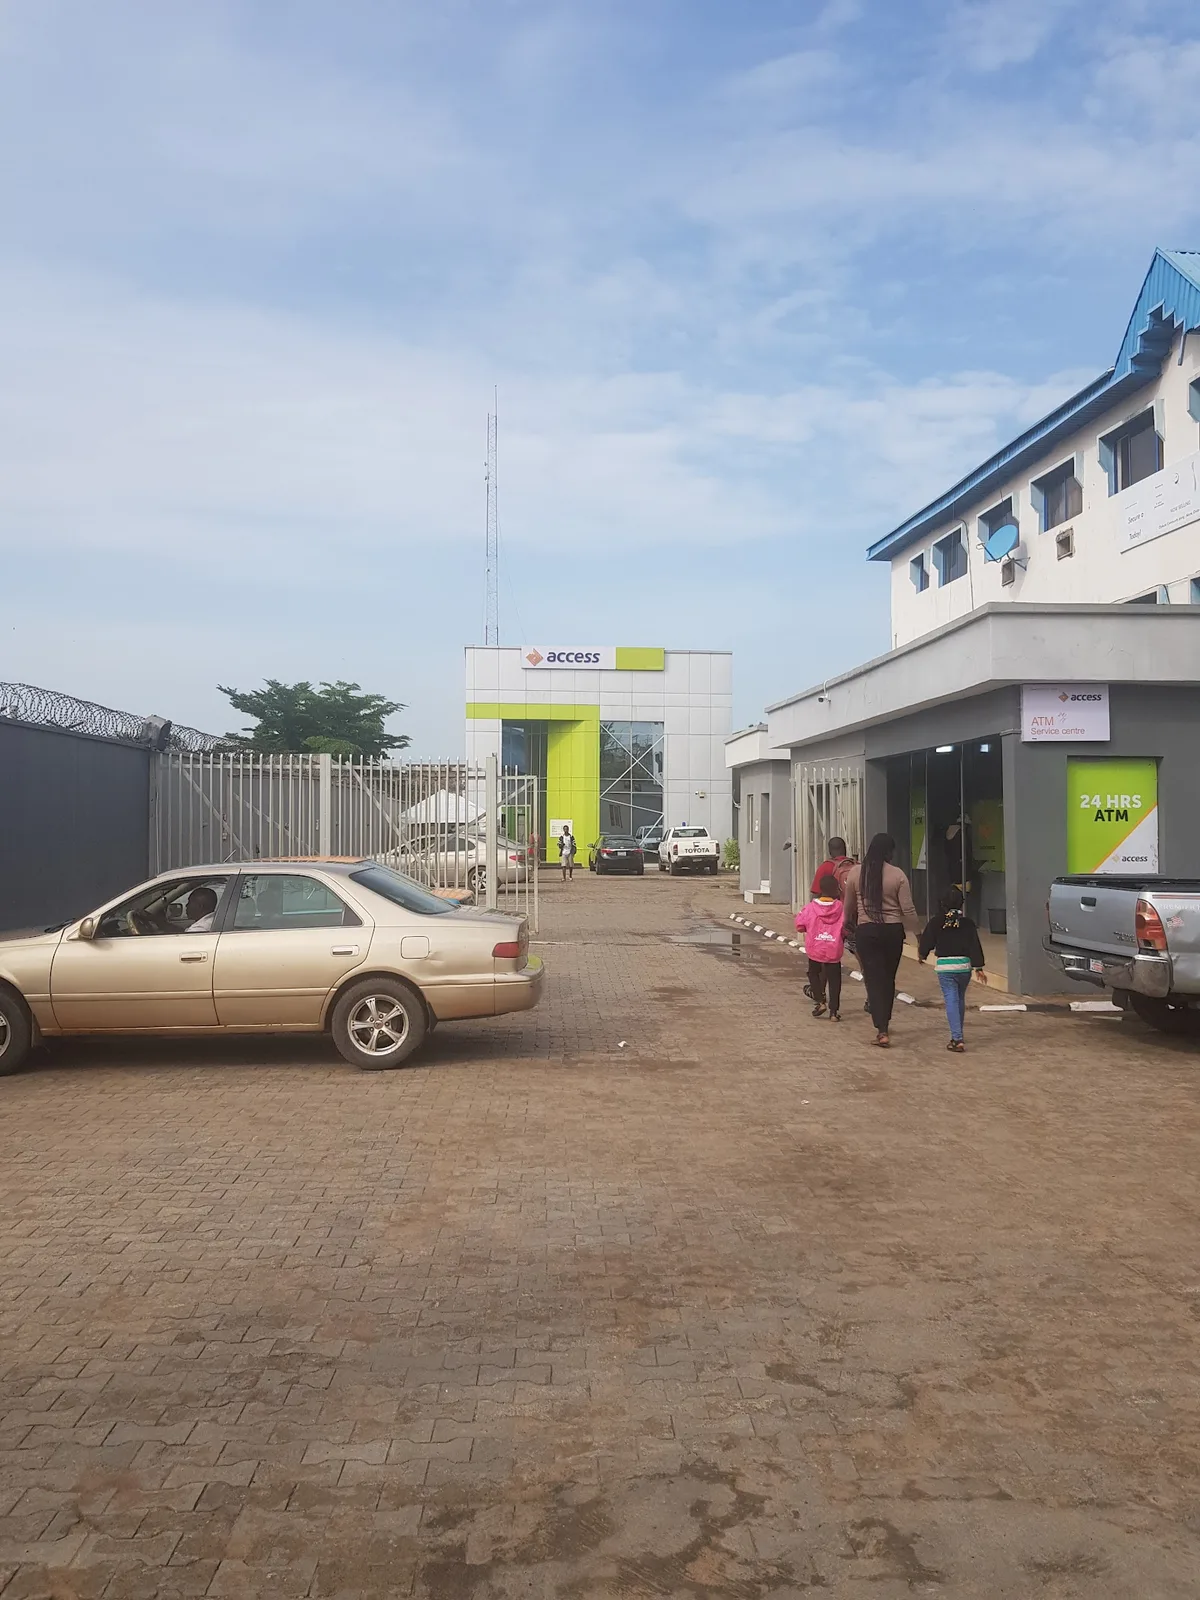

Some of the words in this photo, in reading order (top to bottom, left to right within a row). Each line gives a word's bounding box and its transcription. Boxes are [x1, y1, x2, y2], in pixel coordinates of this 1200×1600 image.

[546, 651, 601, 663] access
[1031, 716, 1054, 726] ATM
[1030, 727, 1060, 736] Service
[1061, 727, 1086, 735] centre
[1080, 794, 1102, 809] 24
[1106, 794, 1142, 809] HRS
[1094, 809, 1129, 822] ATM
